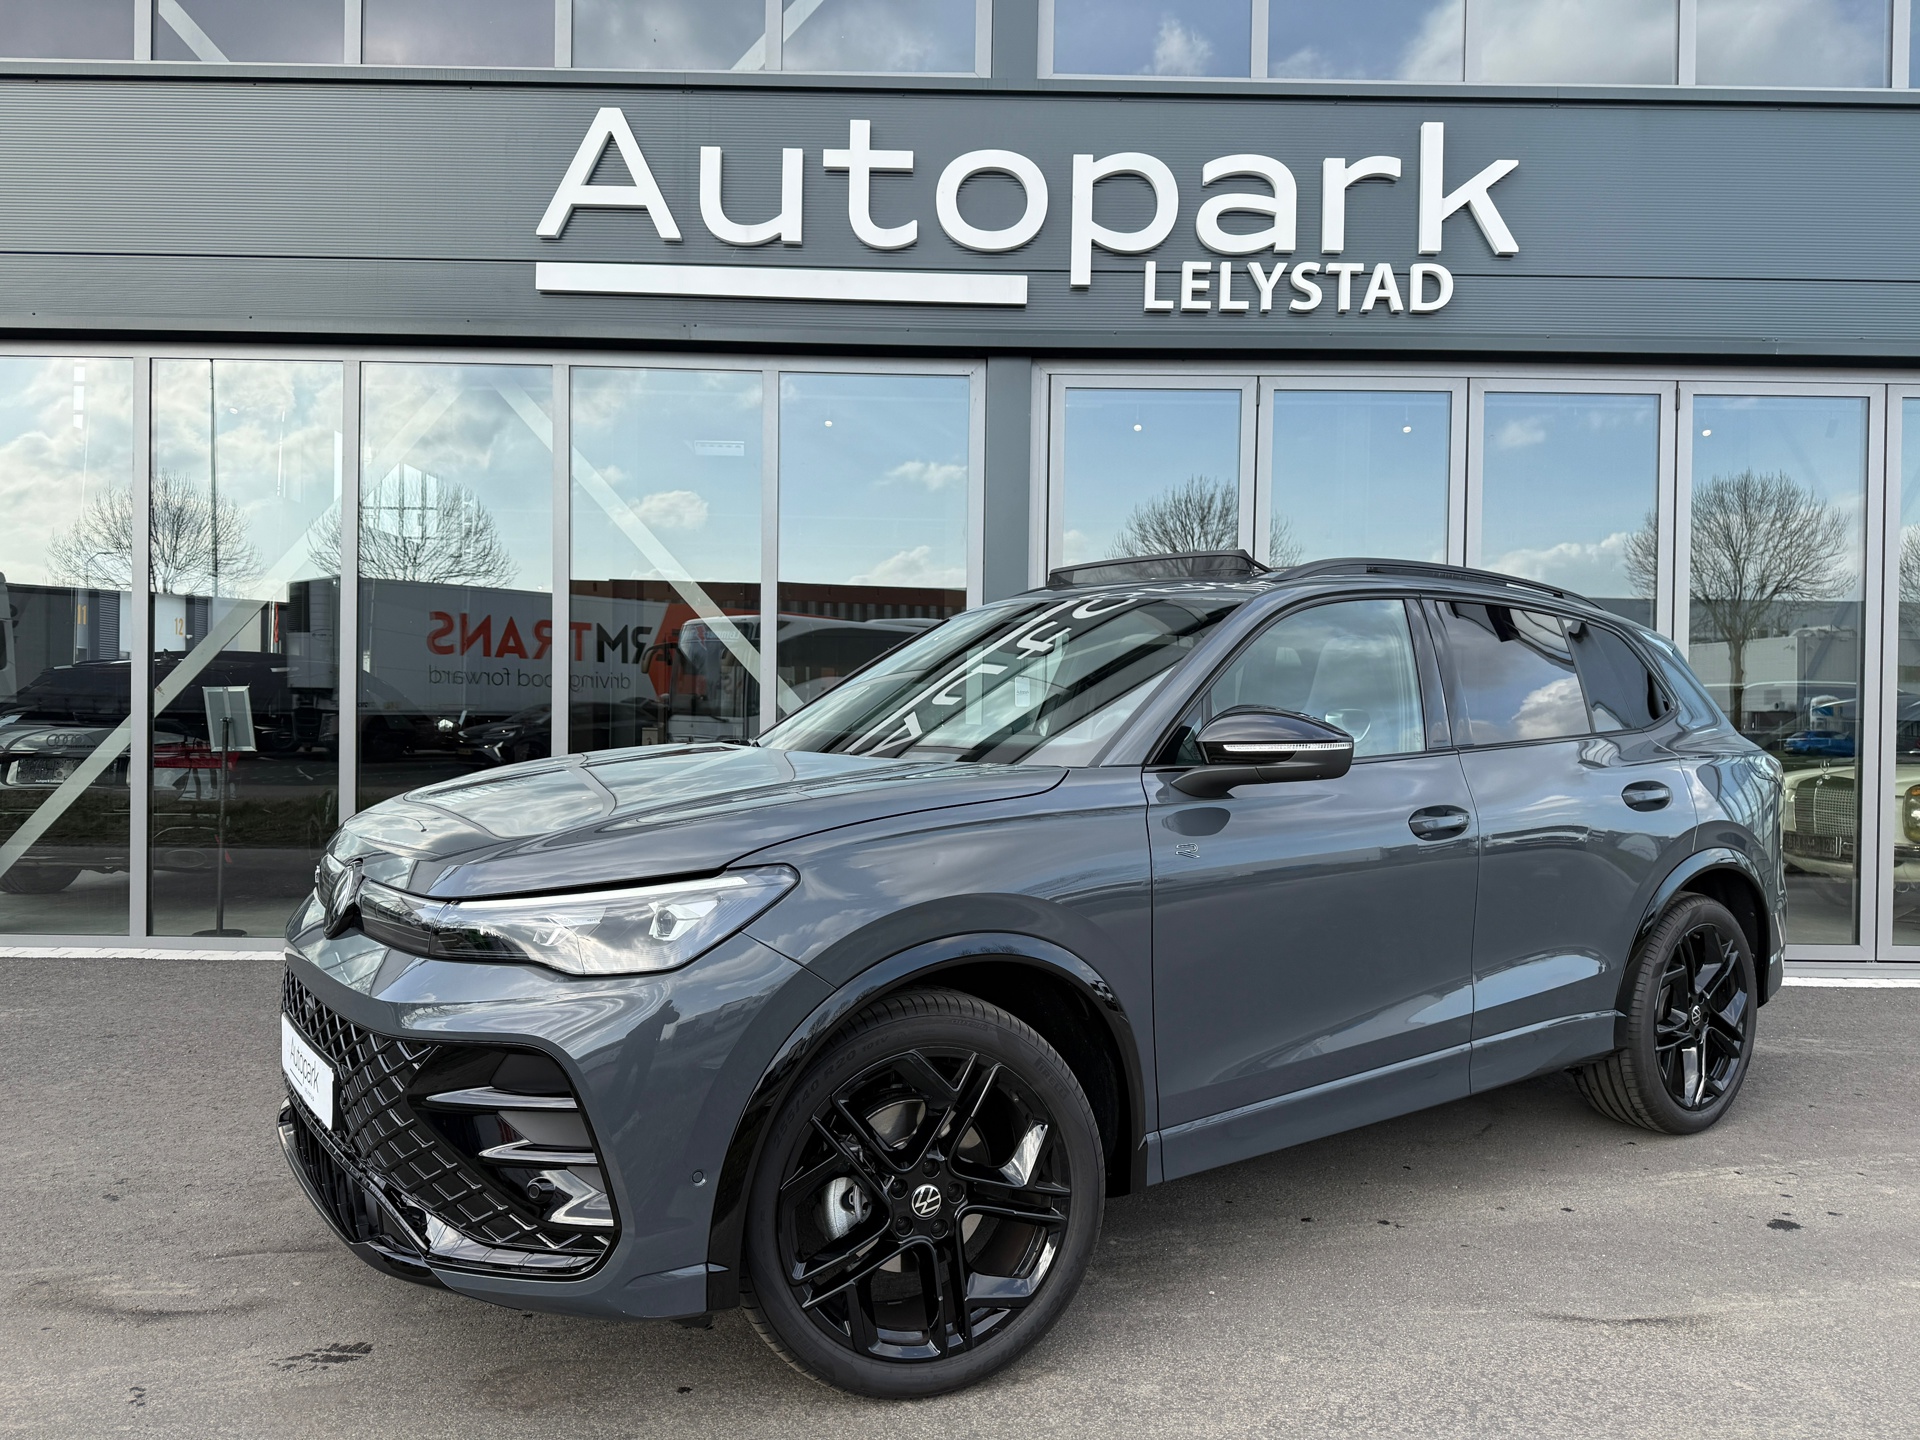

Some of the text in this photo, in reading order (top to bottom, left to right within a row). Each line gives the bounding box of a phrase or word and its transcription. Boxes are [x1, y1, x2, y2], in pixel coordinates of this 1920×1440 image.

[536, 107, 1520, 290] Autopark
[1143, 259, 1454, 315] LELYSTAD
[174, 617, 184, 636] 12
[290, 1036, 320, 1094] Autopark
[823, 1048, 857, 1080] R20
[1034, 1055, 1071, 1101] PIRELLI
